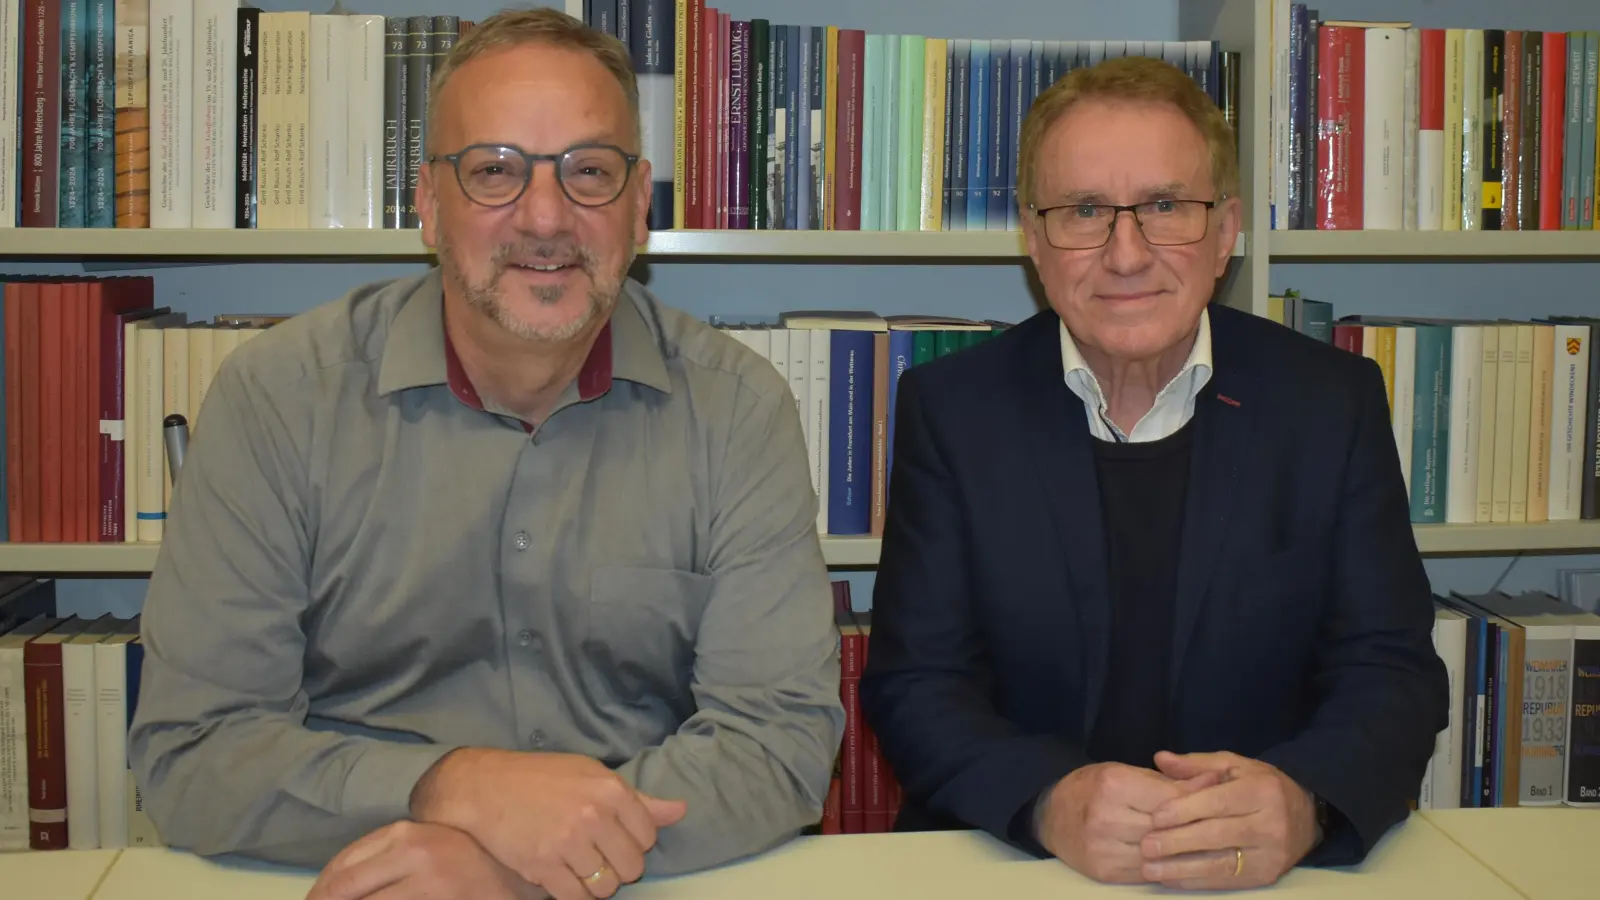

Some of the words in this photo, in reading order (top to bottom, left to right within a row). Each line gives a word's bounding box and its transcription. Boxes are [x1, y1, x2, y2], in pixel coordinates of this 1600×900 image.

[37, 19, 45, 45] Geschichte
[97, 3, 105, 61] KEMPFENBRUNN
[392, 41, 403, 50] 73
[416, 41, 427, 49] 73
[441, 40, 451, 49] 73
[35, 97, 46, 133] Meiersberg
[731, 83, 742, 124] ERNST
[1572, 88, 1580, 123] Purrmann
[35, 135, 43, 153] Jahre
[386, 120, 398, 190] JAHRBUCH
[409, 119, 421, 189] JAHRBUCH
[35, 154, 43, 166] 800
[385, 205, 406, 214] 204
[849, 416, 853, 424] am
[1524, 675, 1567, 700] 1918
[1523, 718, 1564, 742] 1933
[1549, 785, 1552, 796] 1
